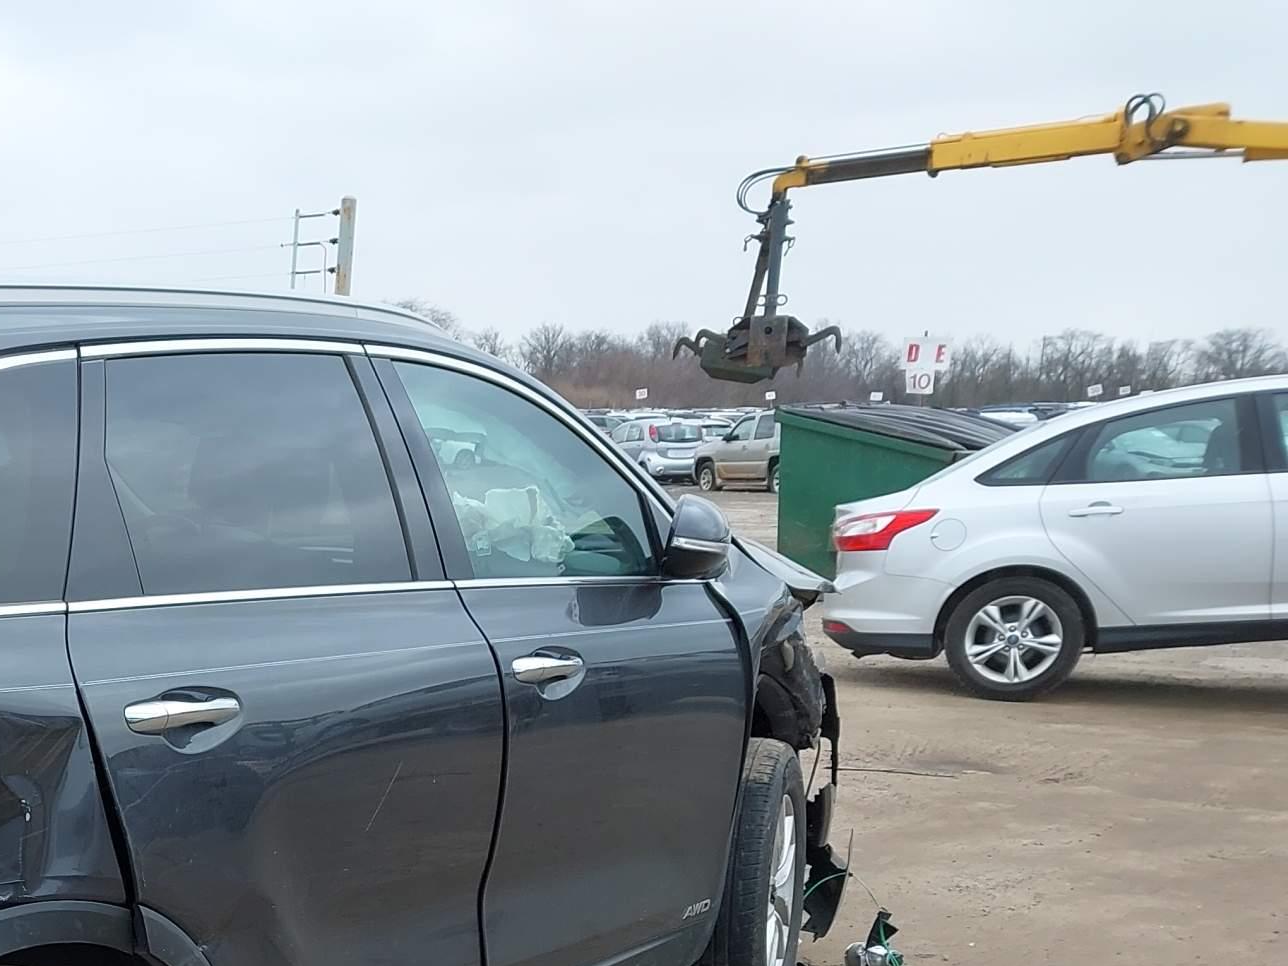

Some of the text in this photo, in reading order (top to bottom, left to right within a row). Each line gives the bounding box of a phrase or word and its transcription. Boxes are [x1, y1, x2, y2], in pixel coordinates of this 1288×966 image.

[907, 344, 947, 363] D E
[910, 373, 931, 390] 10
[682, 899, 711, 920] AWD
